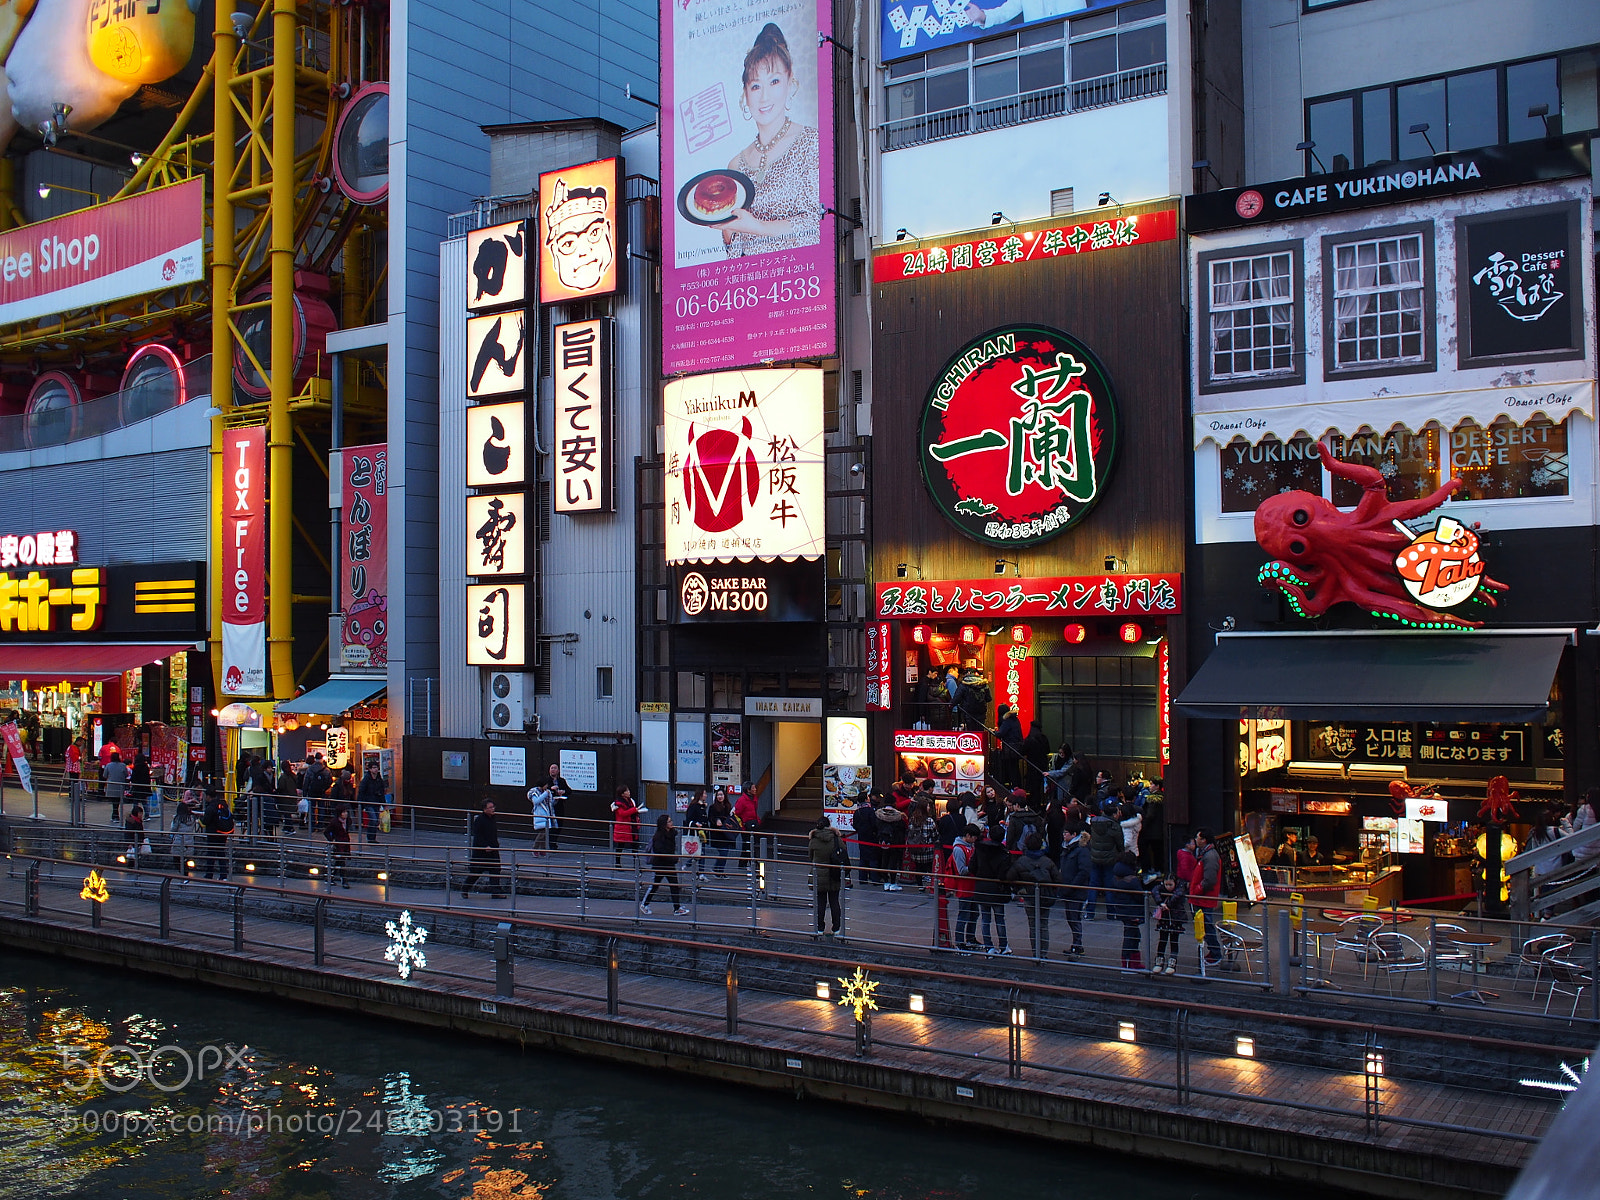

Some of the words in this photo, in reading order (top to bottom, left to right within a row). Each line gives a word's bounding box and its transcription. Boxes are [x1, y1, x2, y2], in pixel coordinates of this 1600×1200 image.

[1275, 184, 1327, 208] CAFE
[1335, 162, 1481, 199] YUKINOHANA
[40, 234, 100, 273] Shop
[786, 262, 815, 275] 4-20-14
[1522, 249, 1565, 262] Dessert
[1522, 261, 1547, 272] Cafe
[675, 275, 821, 318] 06-6468-4538
[932, 333, 1016, 411] ICHIRAN
[561, 327, 597, 505] 旨くて安い
[1504, 396, 1543, 407] Dessert
[1546, 393, 1573, 406] Cafe
[929, 352, 1097, 502] 一蘭
[1209, 421, 1243, 431] Dessert
[1245, 418, 1267, 430] Cafe
[1452, 425, 1552, 449] DESSERT
[234, 440, 250, 511] Tax
[374, 451, 387, 495] 二代目
[1452, 447, 1510, 468] CAFE
[668, 450, 681, 526] 焼肉
[767, 434, 801, 529] 松阪牛
[349, 455, 373, 599] とんぼり
[984, 506, 1071, 539] 昭和35年創業
[234, 520, 249, 612] Free
[710, 578, 740, 589] SAKE
[741, 577, 767, 589] BAR
[1400, 542, 1485, 596] Tako
[710, 591, 768, 611] M300
[880, 578, 1178, 616] 天然とんこつラーメン専門店
[866, 627, 880, 706] ラーメン一蘭
[880, 624, 891, 710] ラーメン一蘭
[755, 701, 778, 712] INAKA
[783, 702, 811, 713] KAIKAN
[327, 733, 338, 765] とんぼり
[894, 735, 957, 750] お土産販売所
[1365, 728, 1412, 742] 入口は
[1366, 743, 1413, 759] ビル裏
[1419, 745, 1512, 761] 側になります
